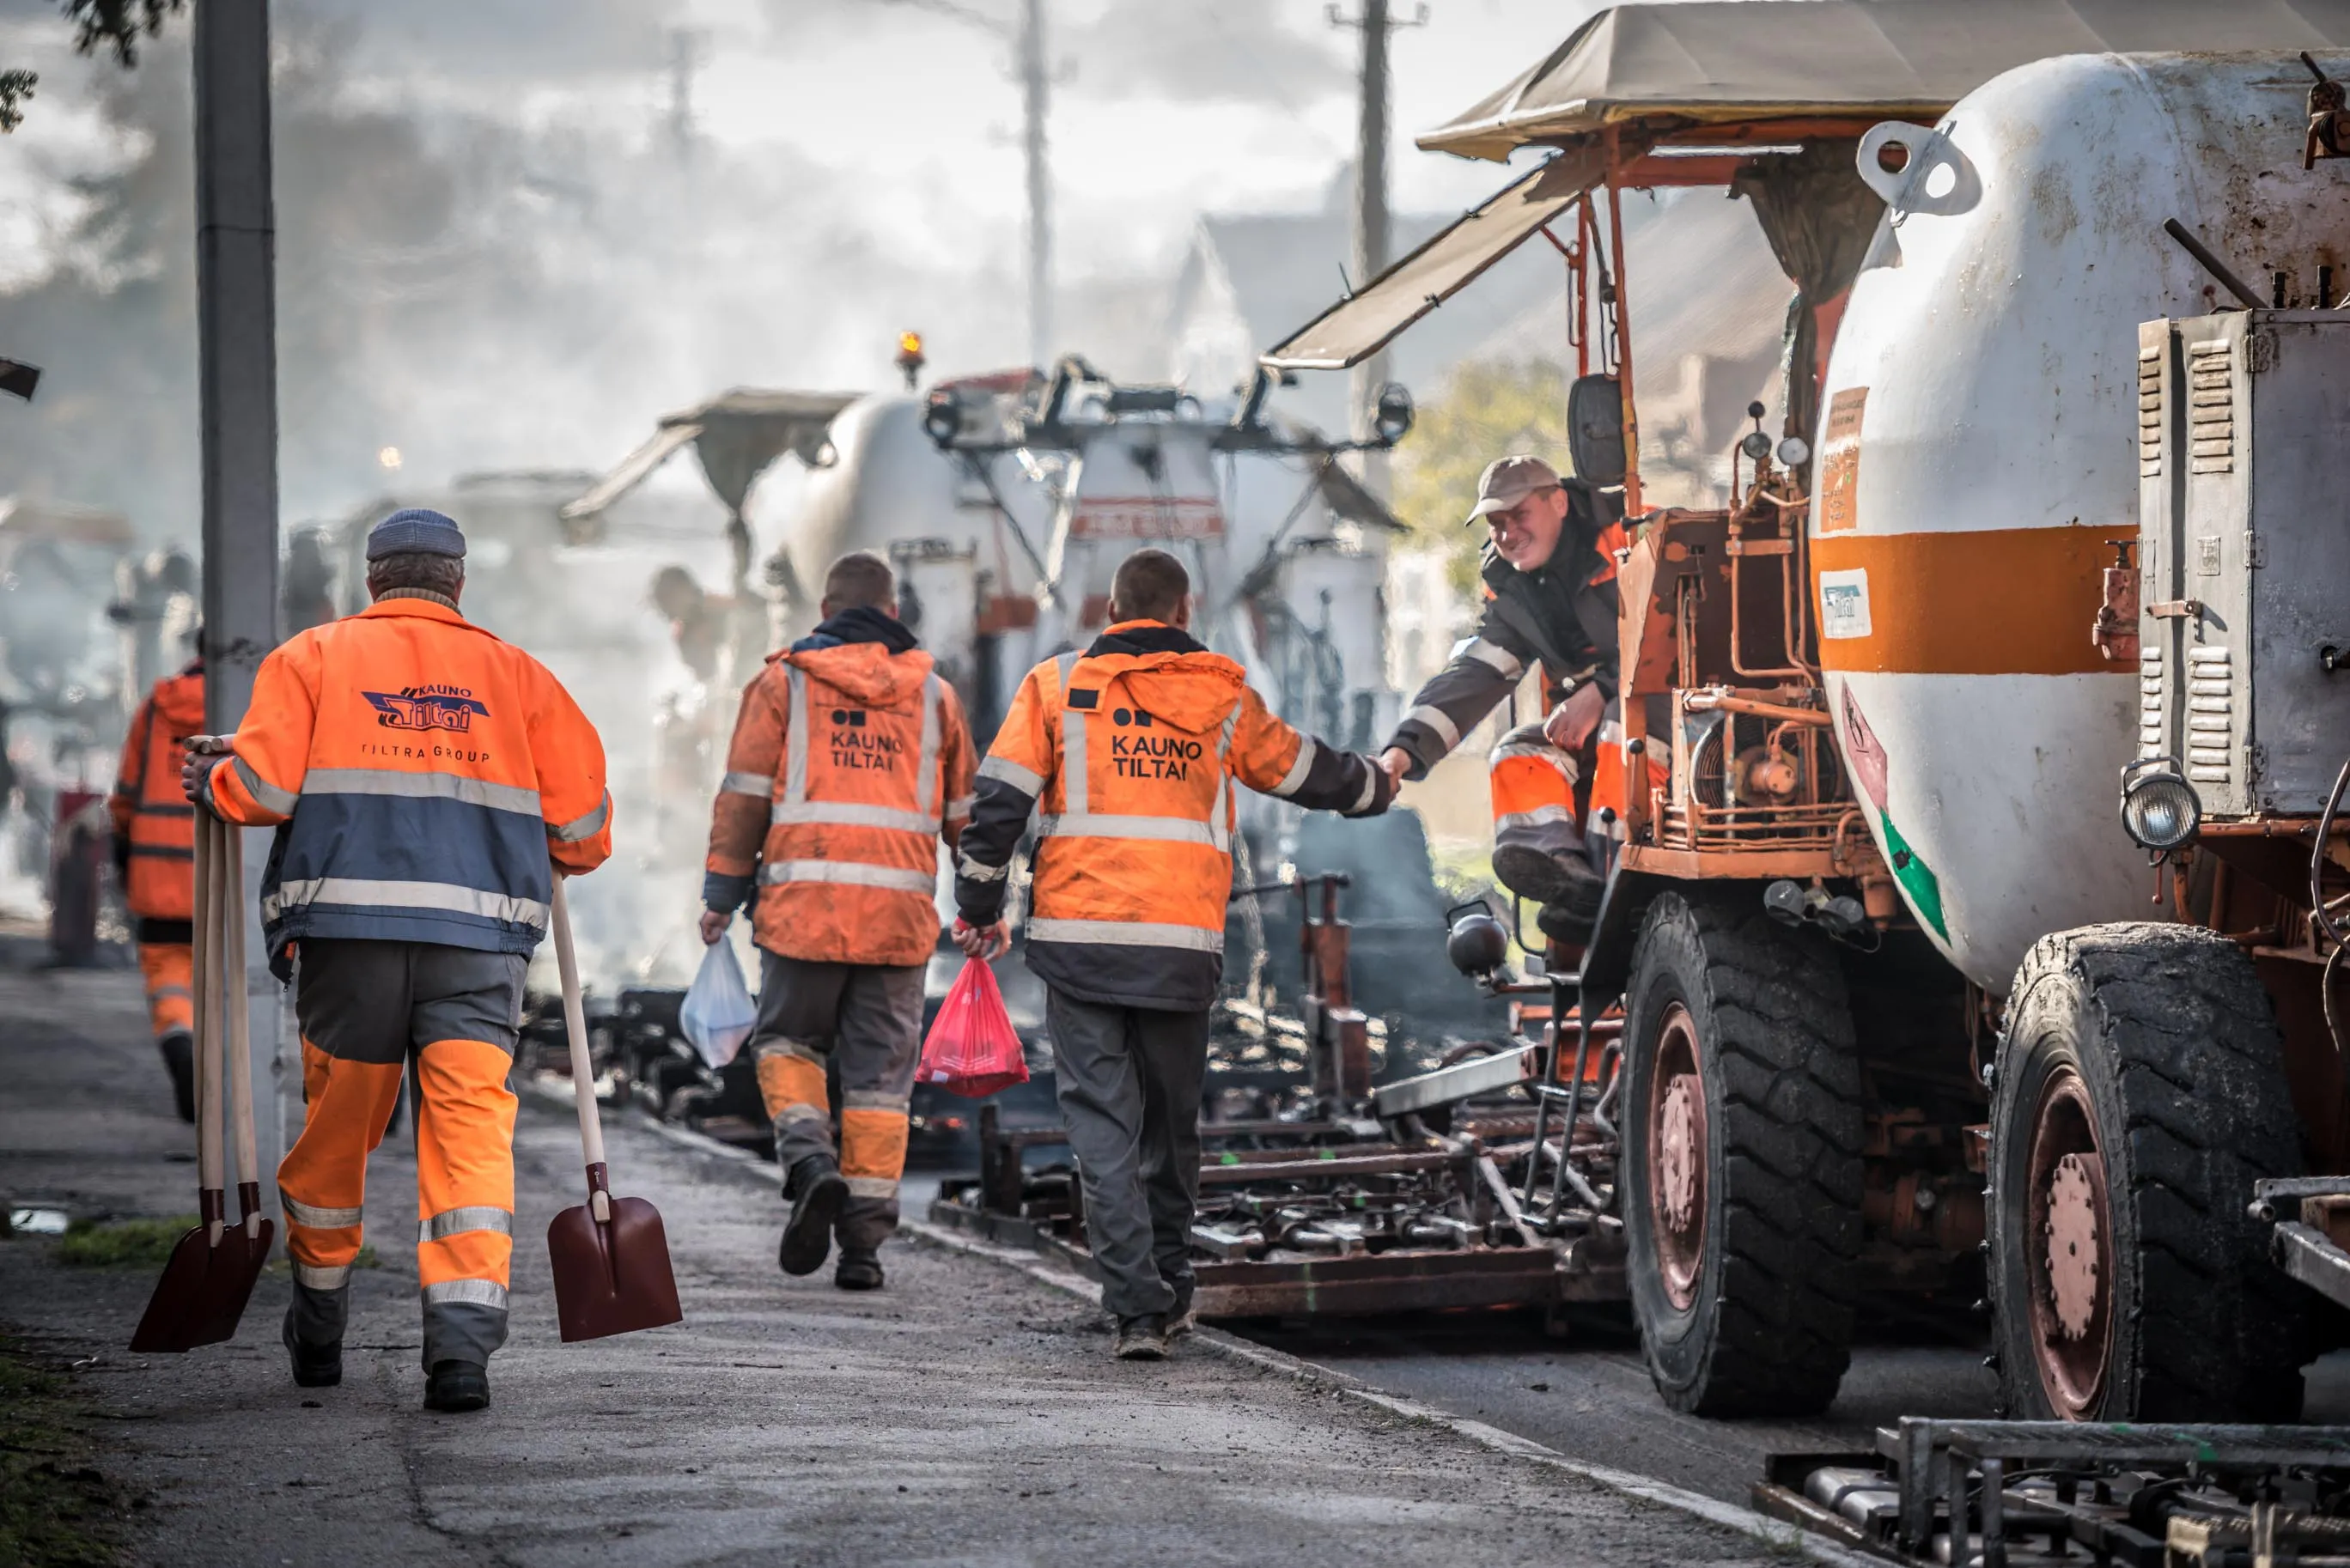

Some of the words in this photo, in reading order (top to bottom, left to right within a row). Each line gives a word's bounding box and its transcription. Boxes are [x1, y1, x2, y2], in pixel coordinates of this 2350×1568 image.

[418, 684, 472, 697] KAUNO
[386, 699, 471, 729] Tiltai
[433, 745, 490, 763] GROUP
[831, 732, 903, 754] KAUNO
[1112, 735, 1202, 760] KAUNO
[831, 750, 892, 771] TILTAI
[1113, 757, 1187, 781] TILTAI
